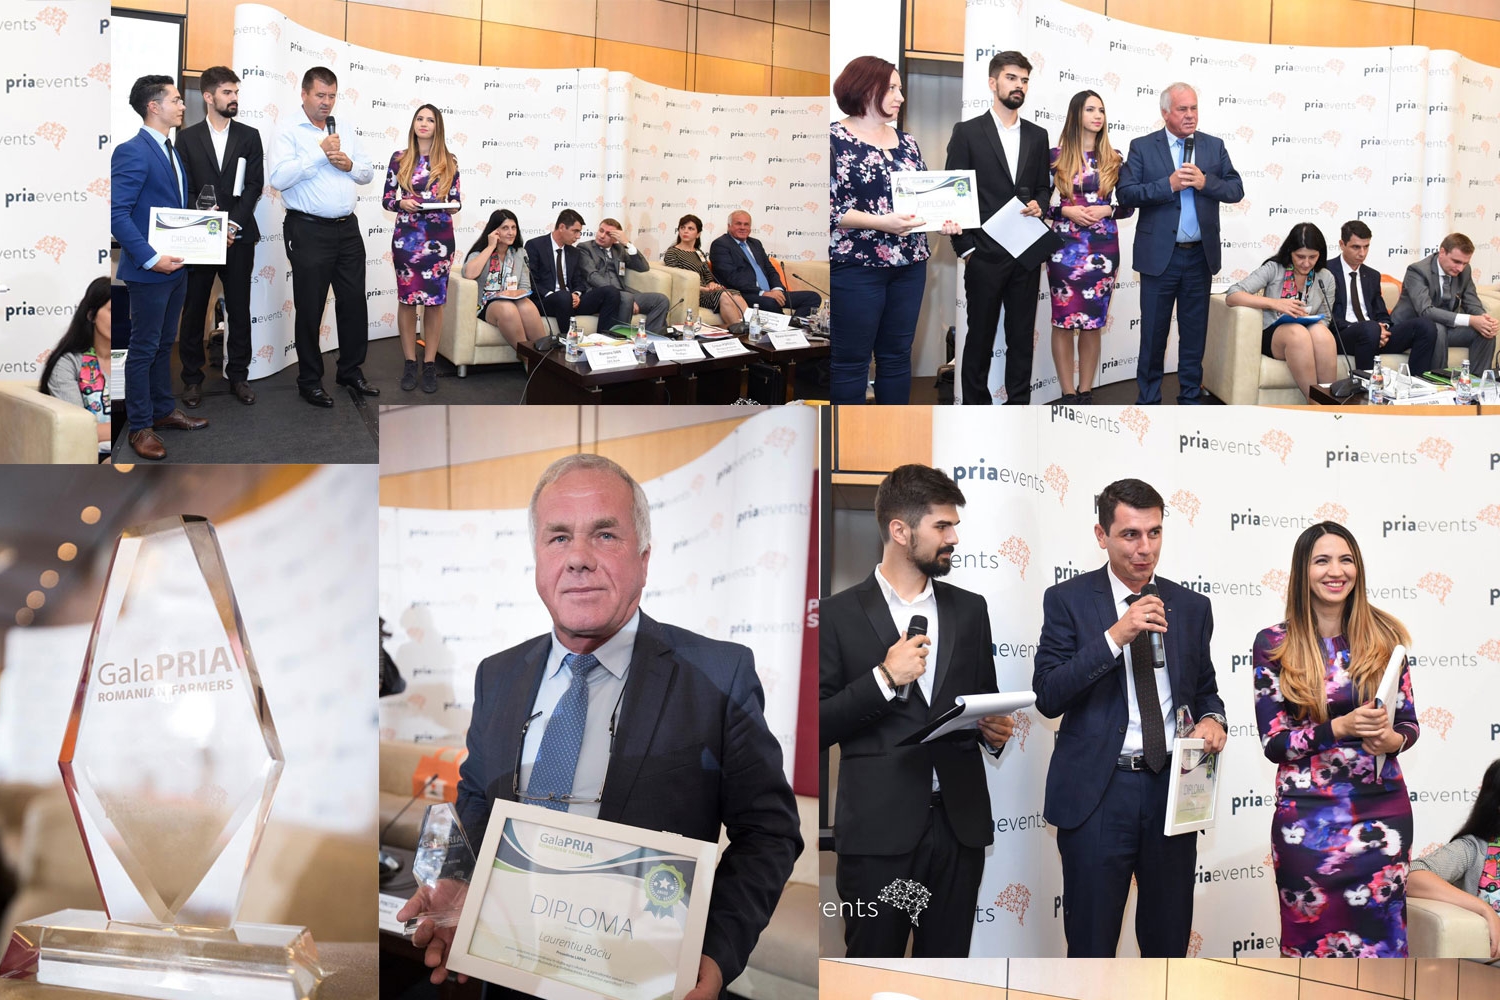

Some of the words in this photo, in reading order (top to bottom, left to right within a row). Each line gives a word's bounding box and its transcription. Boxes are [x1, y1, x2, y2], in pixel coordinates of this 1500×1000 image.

[1035, 15, 1076, 38] priaevents
[291, 42, 322, 59] priaevents
[1110, 40, 1155, 56] priaevents
[350, 61, 387, 76] priaevents
[1190, 54, 1238, 67] priaevents
[1275, 62, 1325, 74] priaevents
[243, 68, 287, 84] priaevents
[1060, 69, 1103, 86] priaevents
[1364, 65, 1418, 76] priaevents
[7, 75, 88, 93] priaevents
[415, 73, 454, 86] priaevents
[484, 81, 525, 90] priaevents
[557, 82, 600, 92] priaevents
[372, 98, 409, 110] priaevents
[1219, 95, 1267, 107] priaevents
[1305, 100, 1356, 111] priaevents
[712, 105, 744, 114] priaevents
[771, 107, 808, 116] priaevents
[1108, 121, 1153, 134] priaevents
[5, 190, 87, 207] priaevents
[918, 199, 956, 208] DIPLOMA
[171, 235, 207, 245] DIPLOMA
[1179, 430, 1260, 456] priaevents
[1326, 446, 1417, 468] priaevents
[953, 458, 1044, 493] priaevents
[737, 499, 810, 528] priaevents
[1383, 515, 1477, 537] priaevents
[730, 619, 799, 635] priaevents
[97, 647, 232, 686] GalaPRIA
[98, 687, 166, 702] ROMANIAN
[172, 679, 233, 695] FARMERS
[1183, 784, 1205, 794] DIPLOMA
[540, 832, 594, 854] GalaPRIA
[530, 894, 634, 940] DIPLOMA
[585, 944, 612, 960] Baciu
